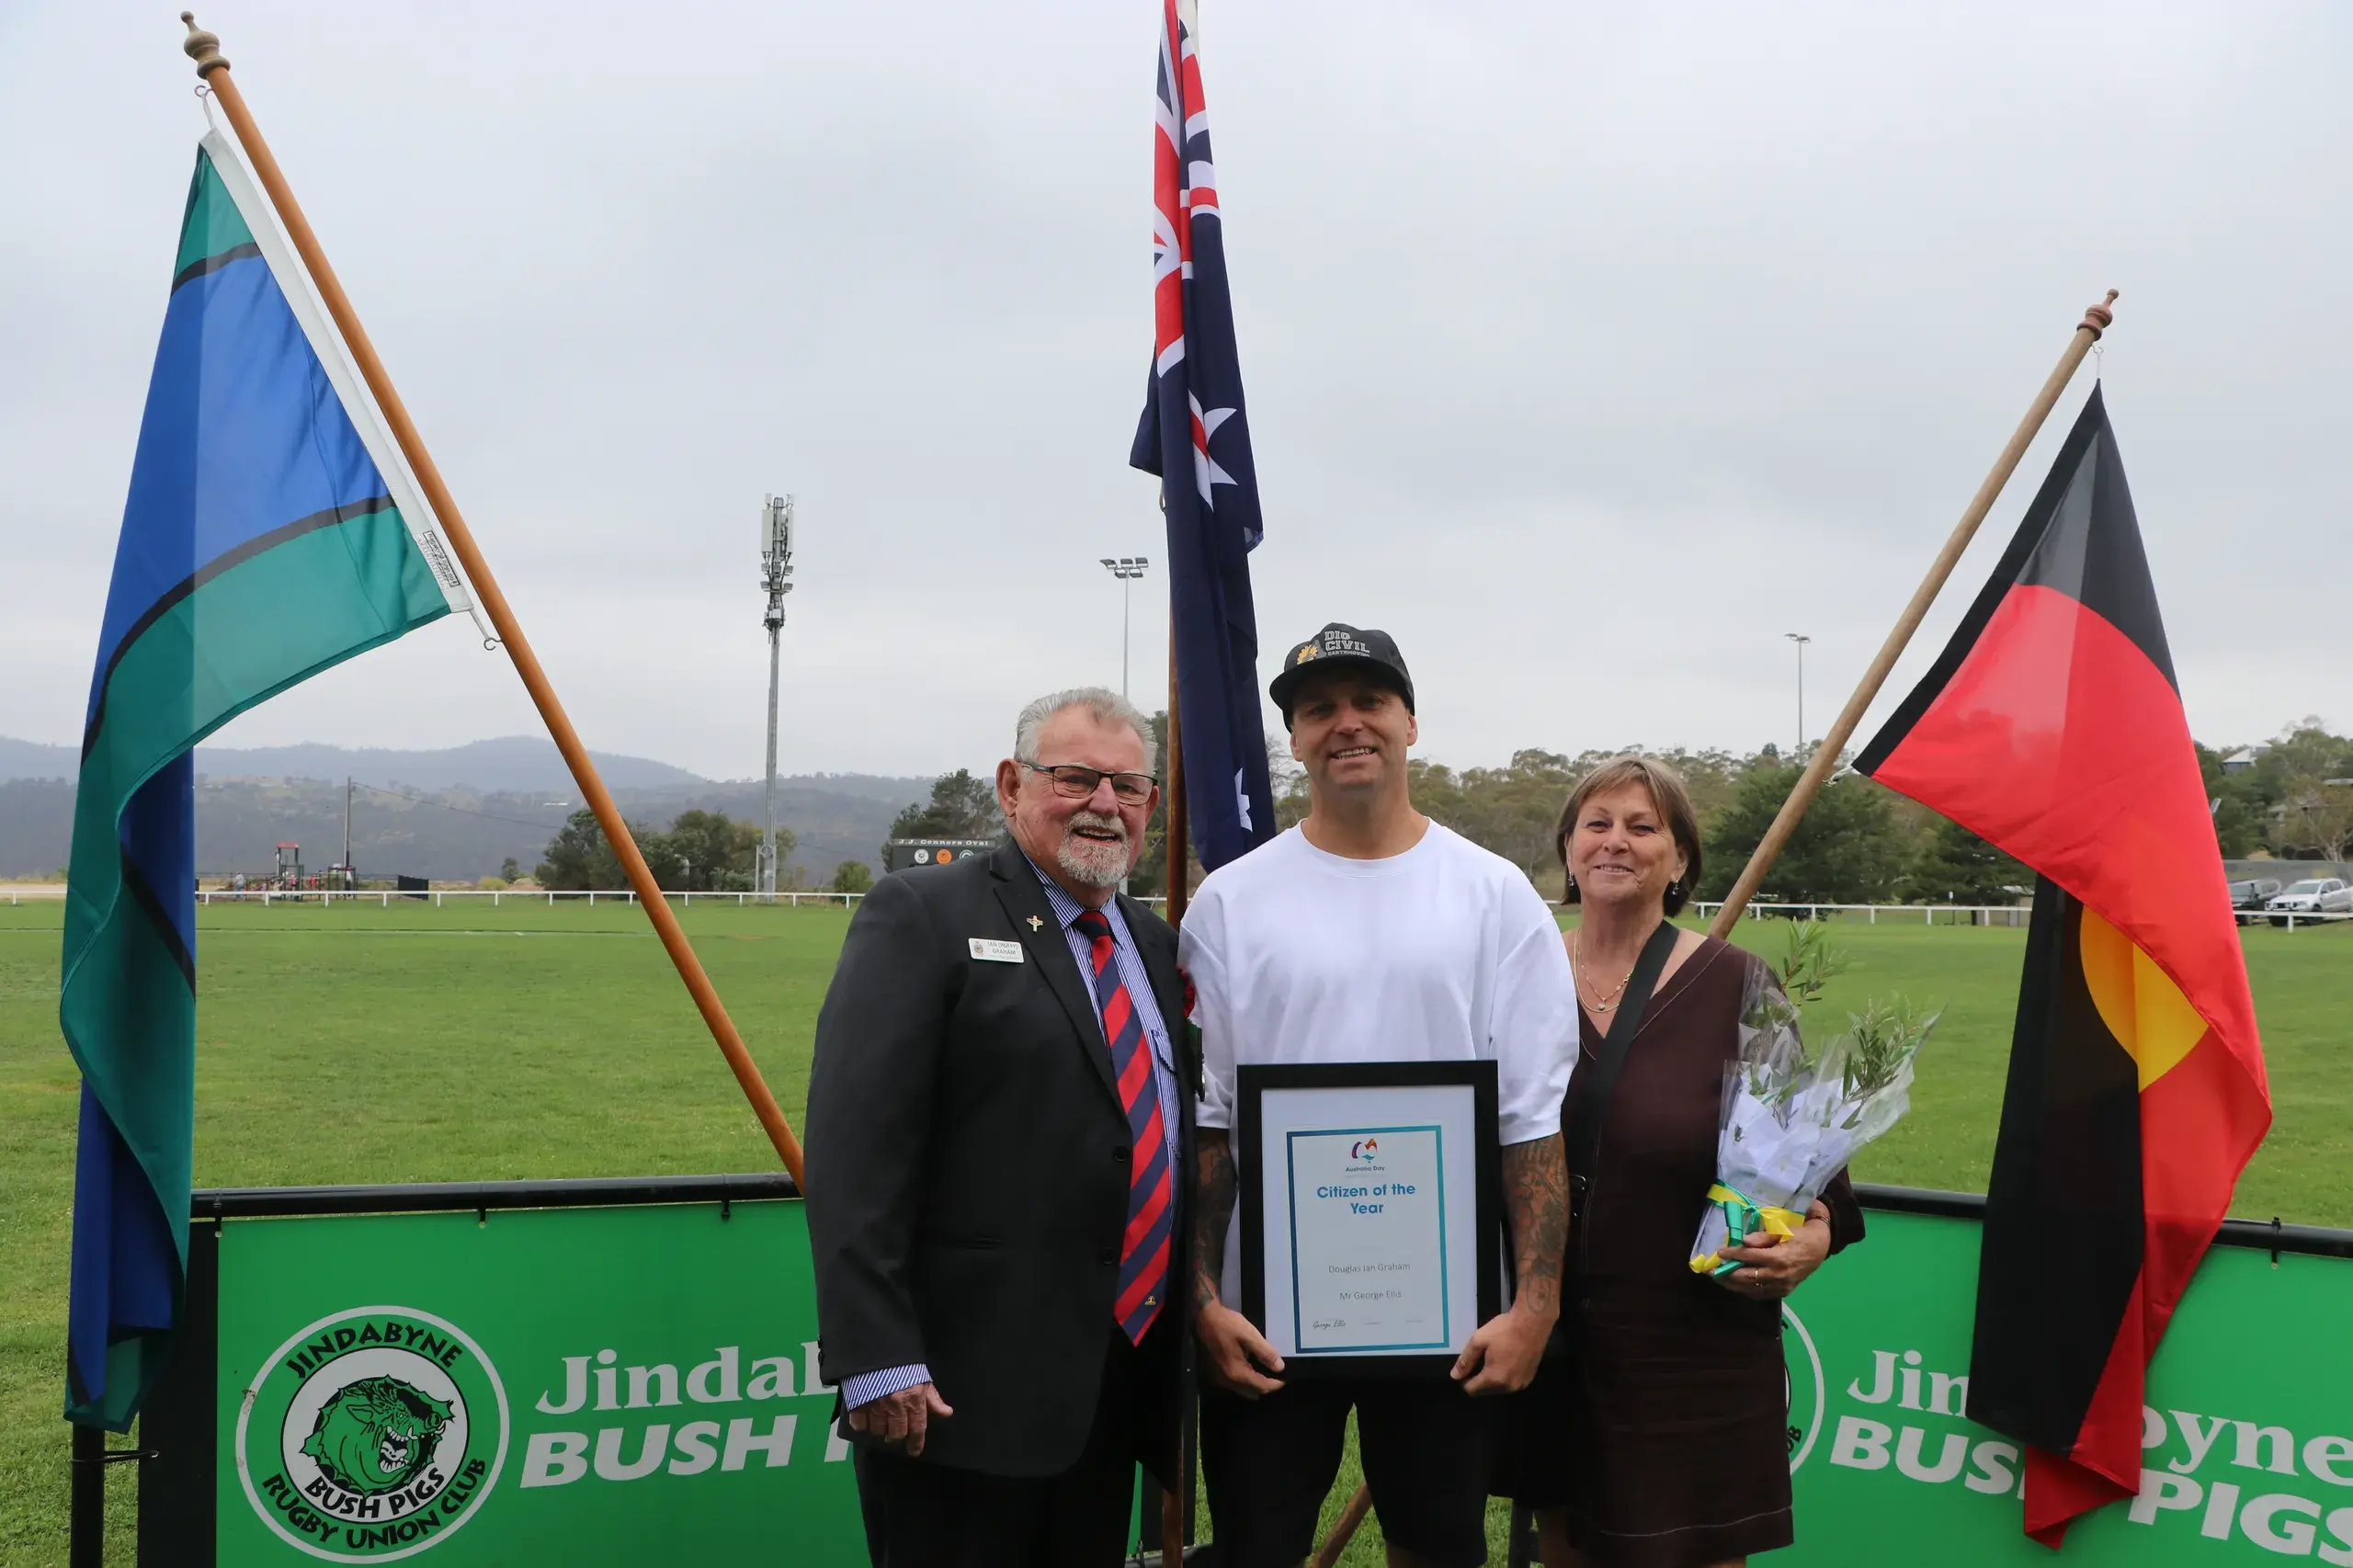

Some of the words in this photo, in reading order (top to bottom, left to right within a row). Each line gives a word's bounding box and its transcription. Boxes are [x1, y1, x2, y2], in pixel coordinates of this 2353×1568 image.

[1324, 631, 1351, 641] DIG
[1325, 640, 1370, 653] CIVIL
[1316, 1186, 1368, 1199] Citizen
[1372, 1184, 1387, 1196] of
[1392, 1183, 1415, 1195] the
[1350, 1202, 1384, 1214] Year
[1328, 1264, 1361, 1274] Douglas
[1378, 1262, 1411, 1272] Graham
[1339, 1292, 1352, 1301] Mr
[1353, 1291, 1384, 1301] George
[1385, 1290, 1402, 1299] Ellis
[286, 1322, 463, 1379] JINDABYNE
[535, 1341, 838, 1415] Jinda
[519, 1414, 799, 1489] BUSH
[1829, 1415, 2025, 1501] BUS
[262, 1472, 339, 1543] RUGBY
[346, 1509, 441, 1550] UNION
[440, 1458, 486, 1515] CLUB
[305, 1476, 381, 1518] BUSH
[388, 1467, 445, 1517] PIGS
